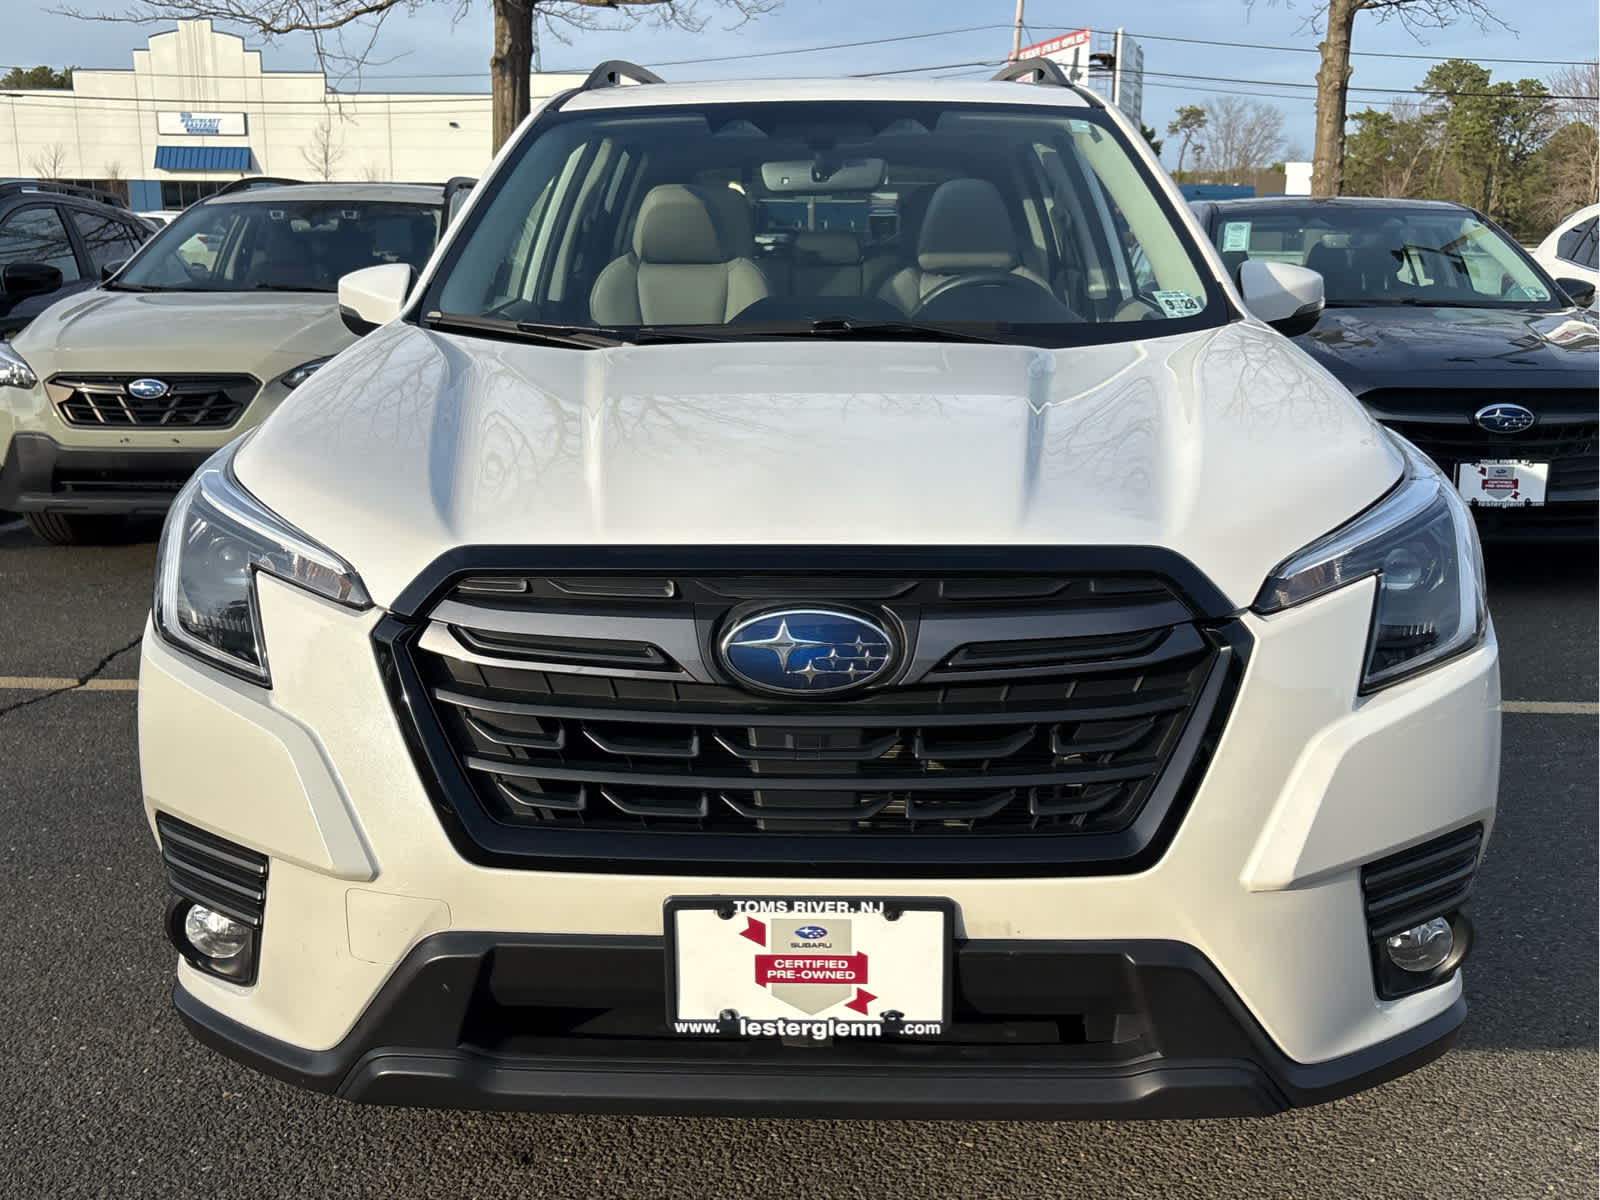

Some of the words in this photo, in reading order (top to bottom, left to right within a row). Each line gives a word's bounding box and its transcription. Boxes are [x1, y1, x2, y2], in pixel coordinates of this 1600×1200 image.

[1180, 298, 1197, 309] 28
[734, 901, 787, 913] TOMS
[861, 901, 884, 913] NJ
[774, 959, 849, 969] CERTIFIED
[767, 969, 856, 980] PRE-OWNED
[674, 1022, 720, 1033] www.
[740, 1019, 881, 1040] lesterglenn
[899, 1022, 941, 1034] .com
